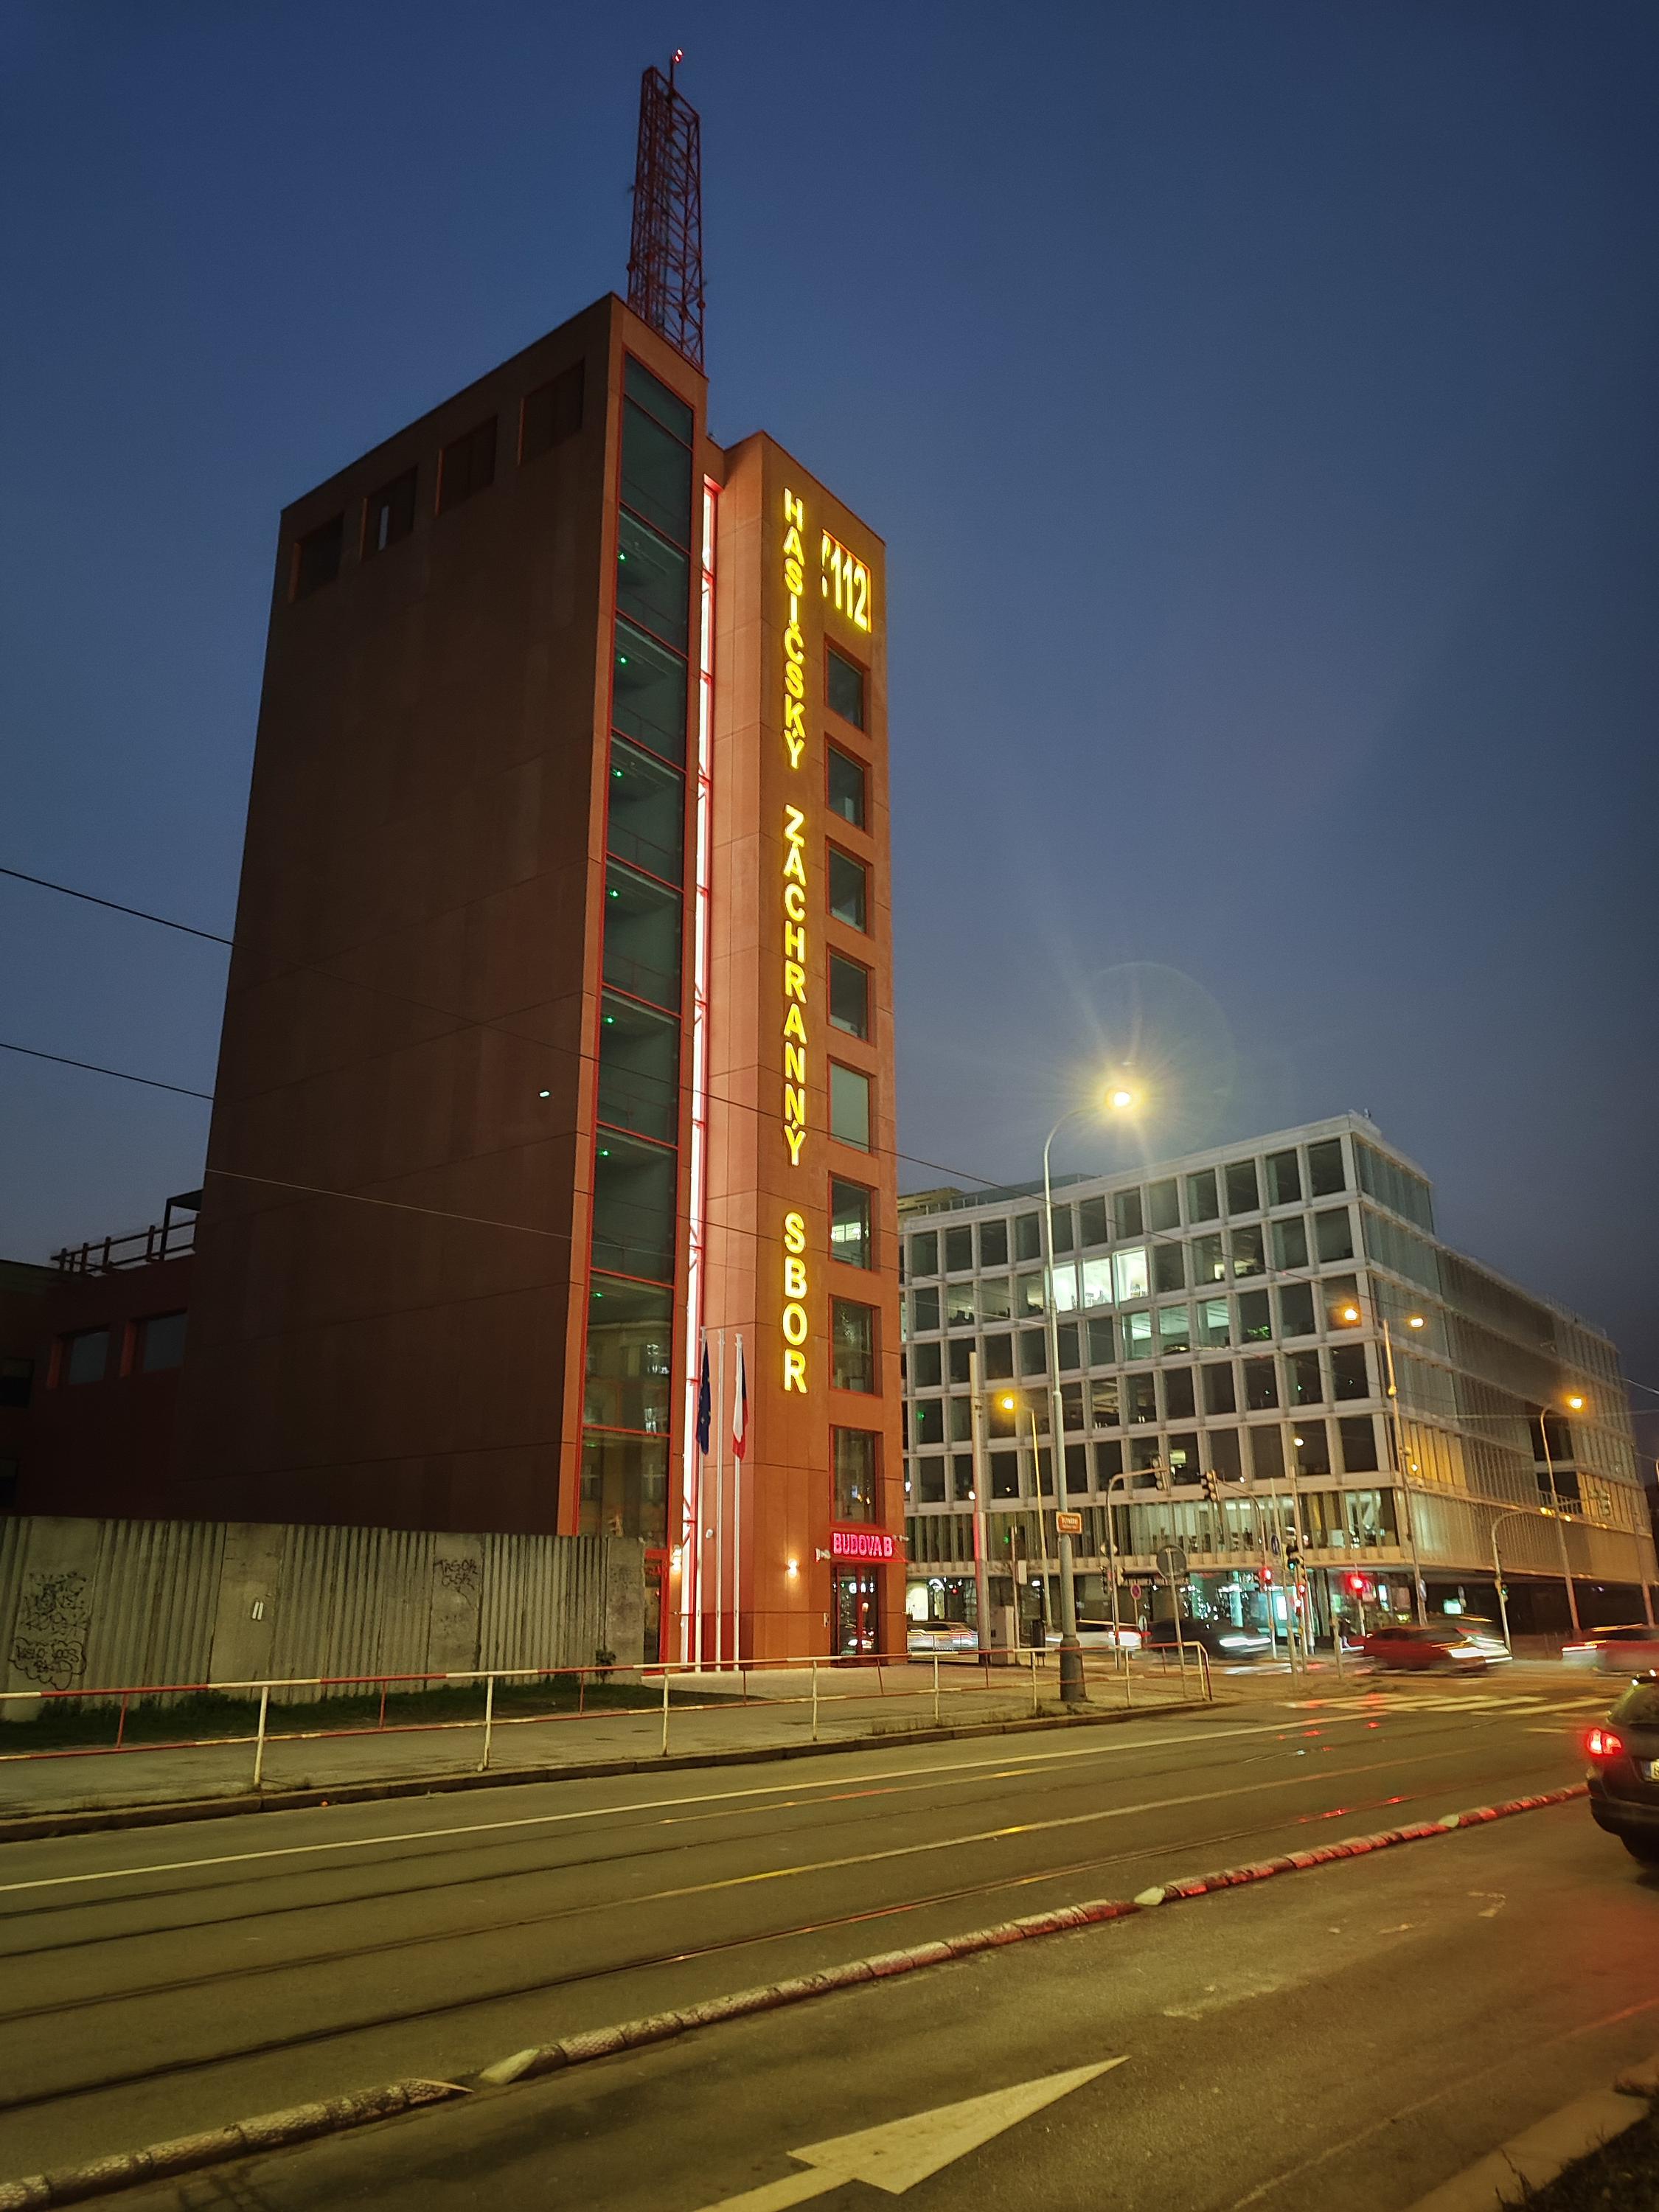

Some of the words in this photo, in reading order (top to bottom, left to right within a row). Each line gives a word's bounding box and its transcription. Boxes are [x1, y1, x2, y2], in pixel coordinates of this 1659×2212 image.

[783, 487, 806, 769] HASIČSKÝ
[783, 804, 807, 1166] ZÁCHRANNÝ
[782, 1211, 808, 1394] SBOR
[832, 1532, 883, 1557] BUDOVA
[883, 1536, 893, 1557] B
